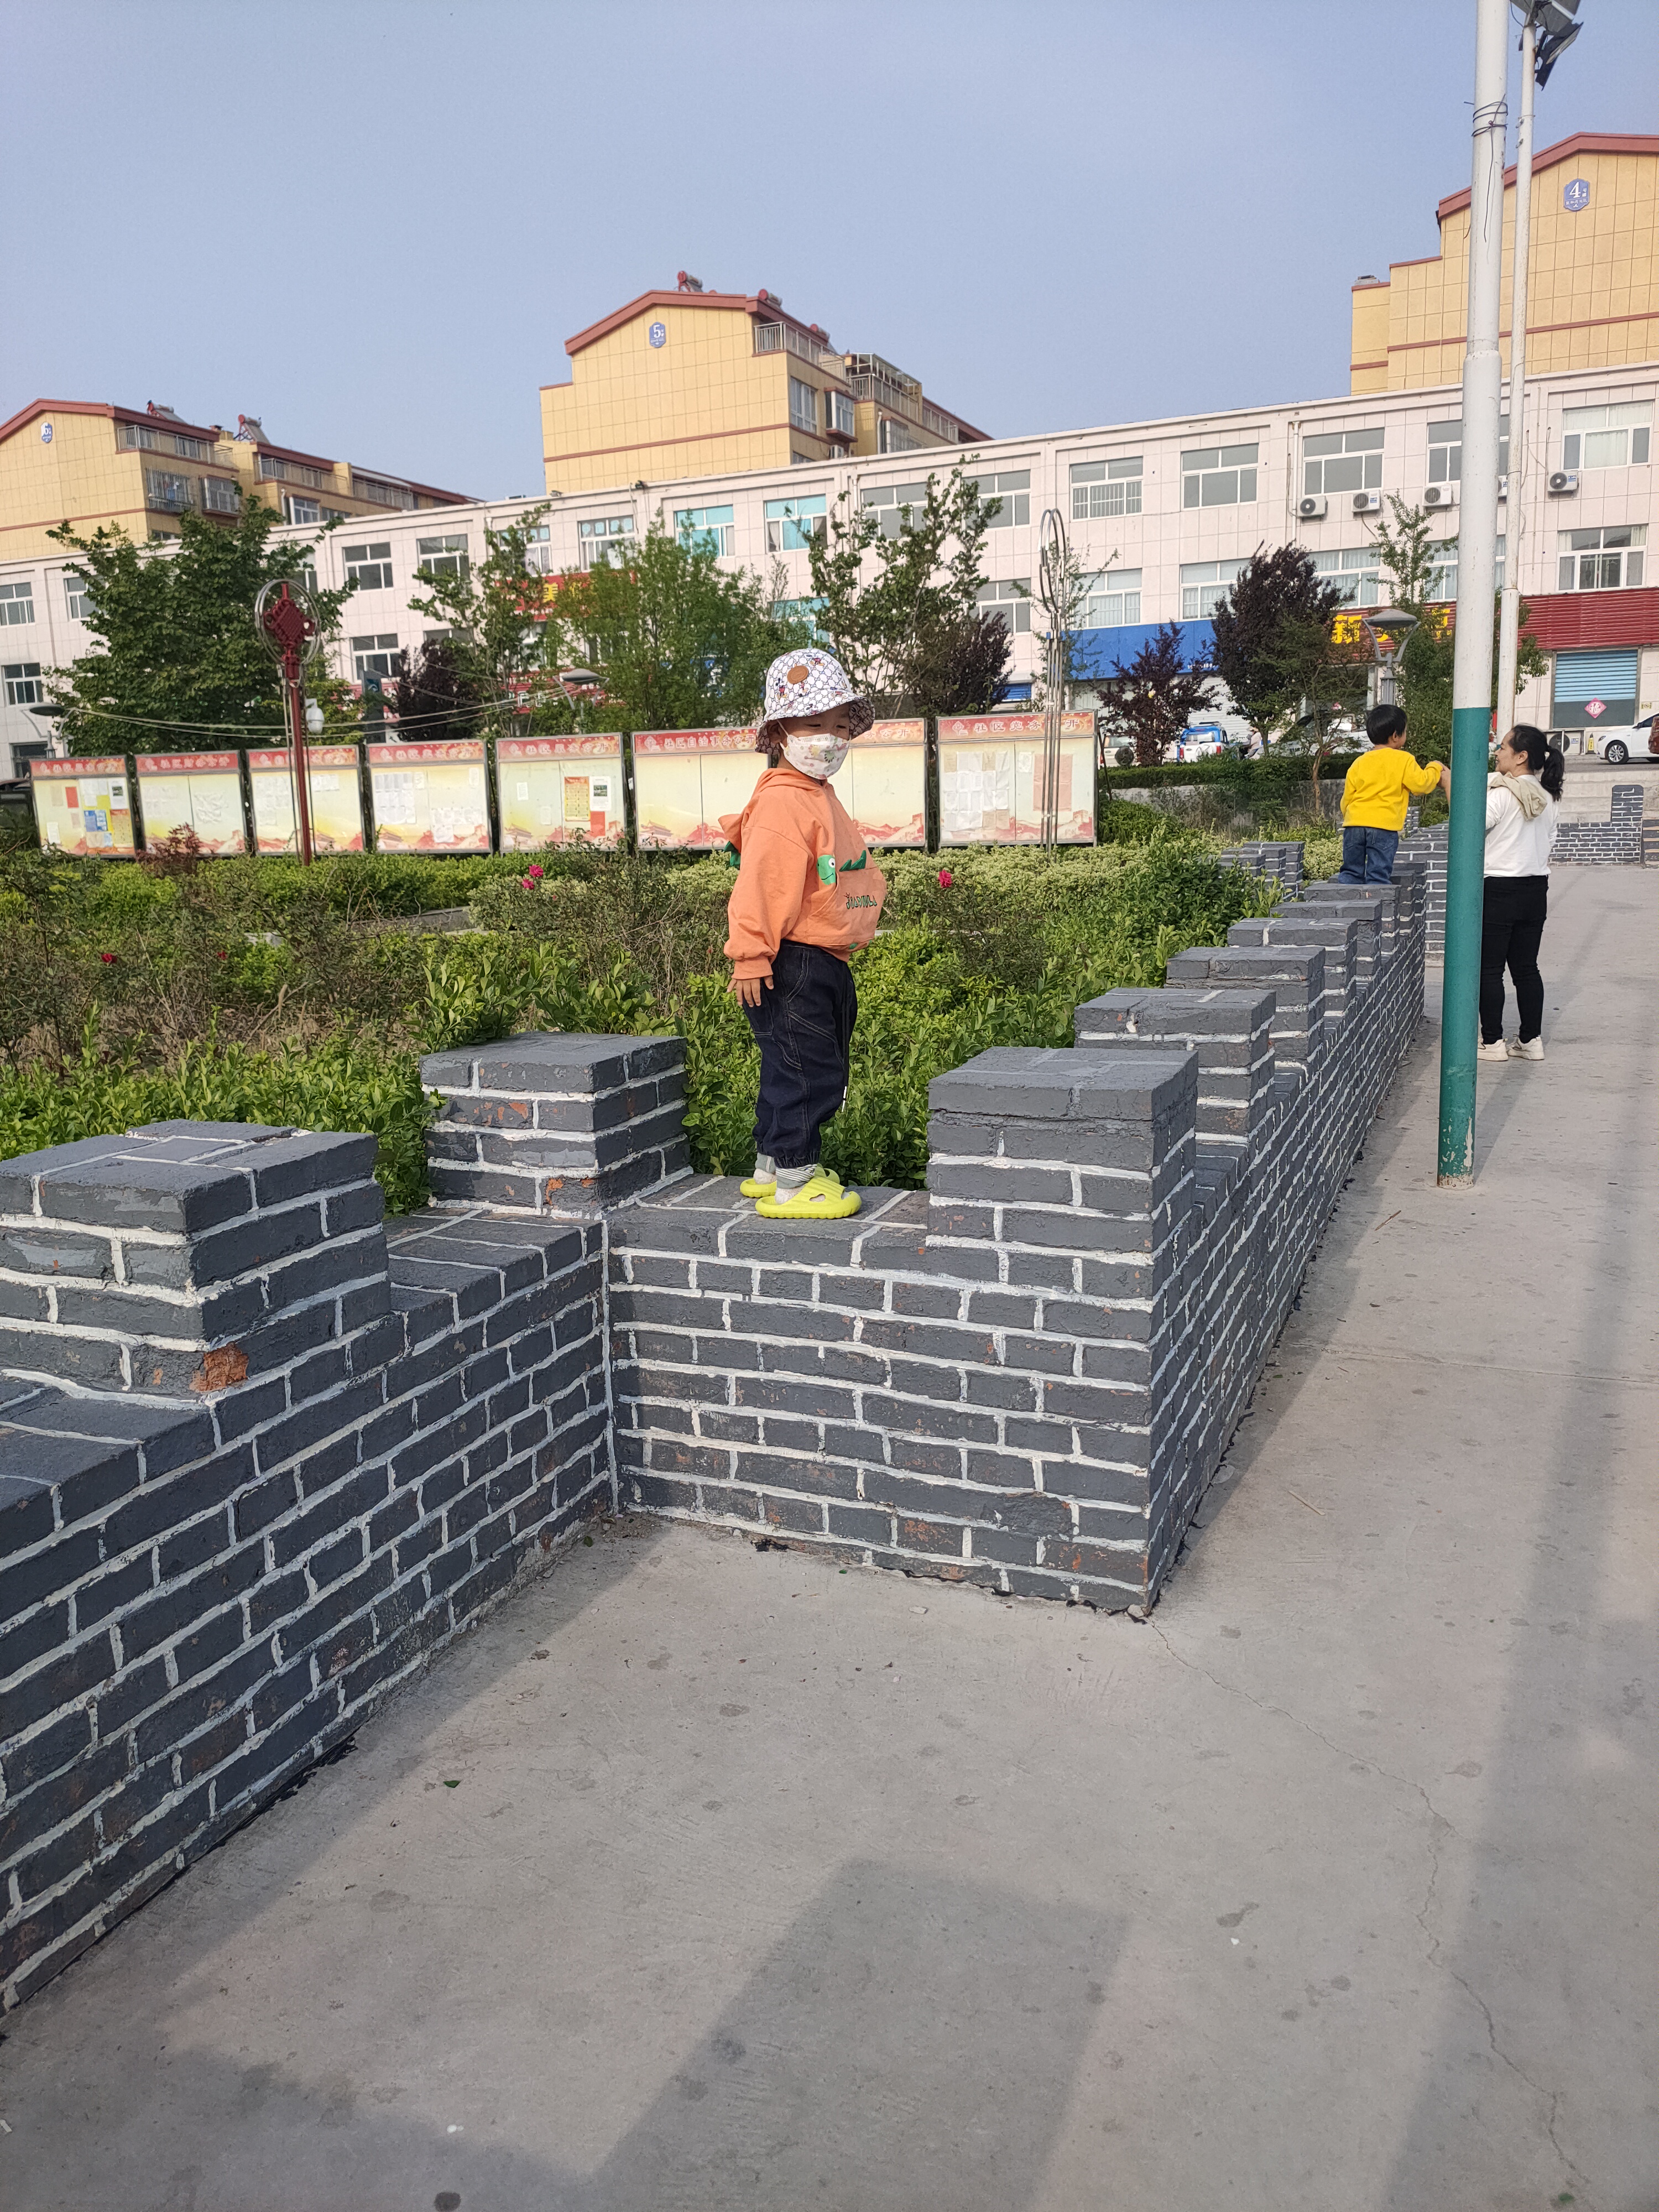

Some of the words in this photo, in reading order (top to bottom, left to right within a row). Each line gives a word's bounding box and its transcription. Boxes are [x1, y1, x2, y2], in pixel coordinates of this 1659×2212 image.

[1569, 181, 1580, 199] 4
[653, 325, 661, 338] 5
[975, 719, 1078, 732] 社区党务开
